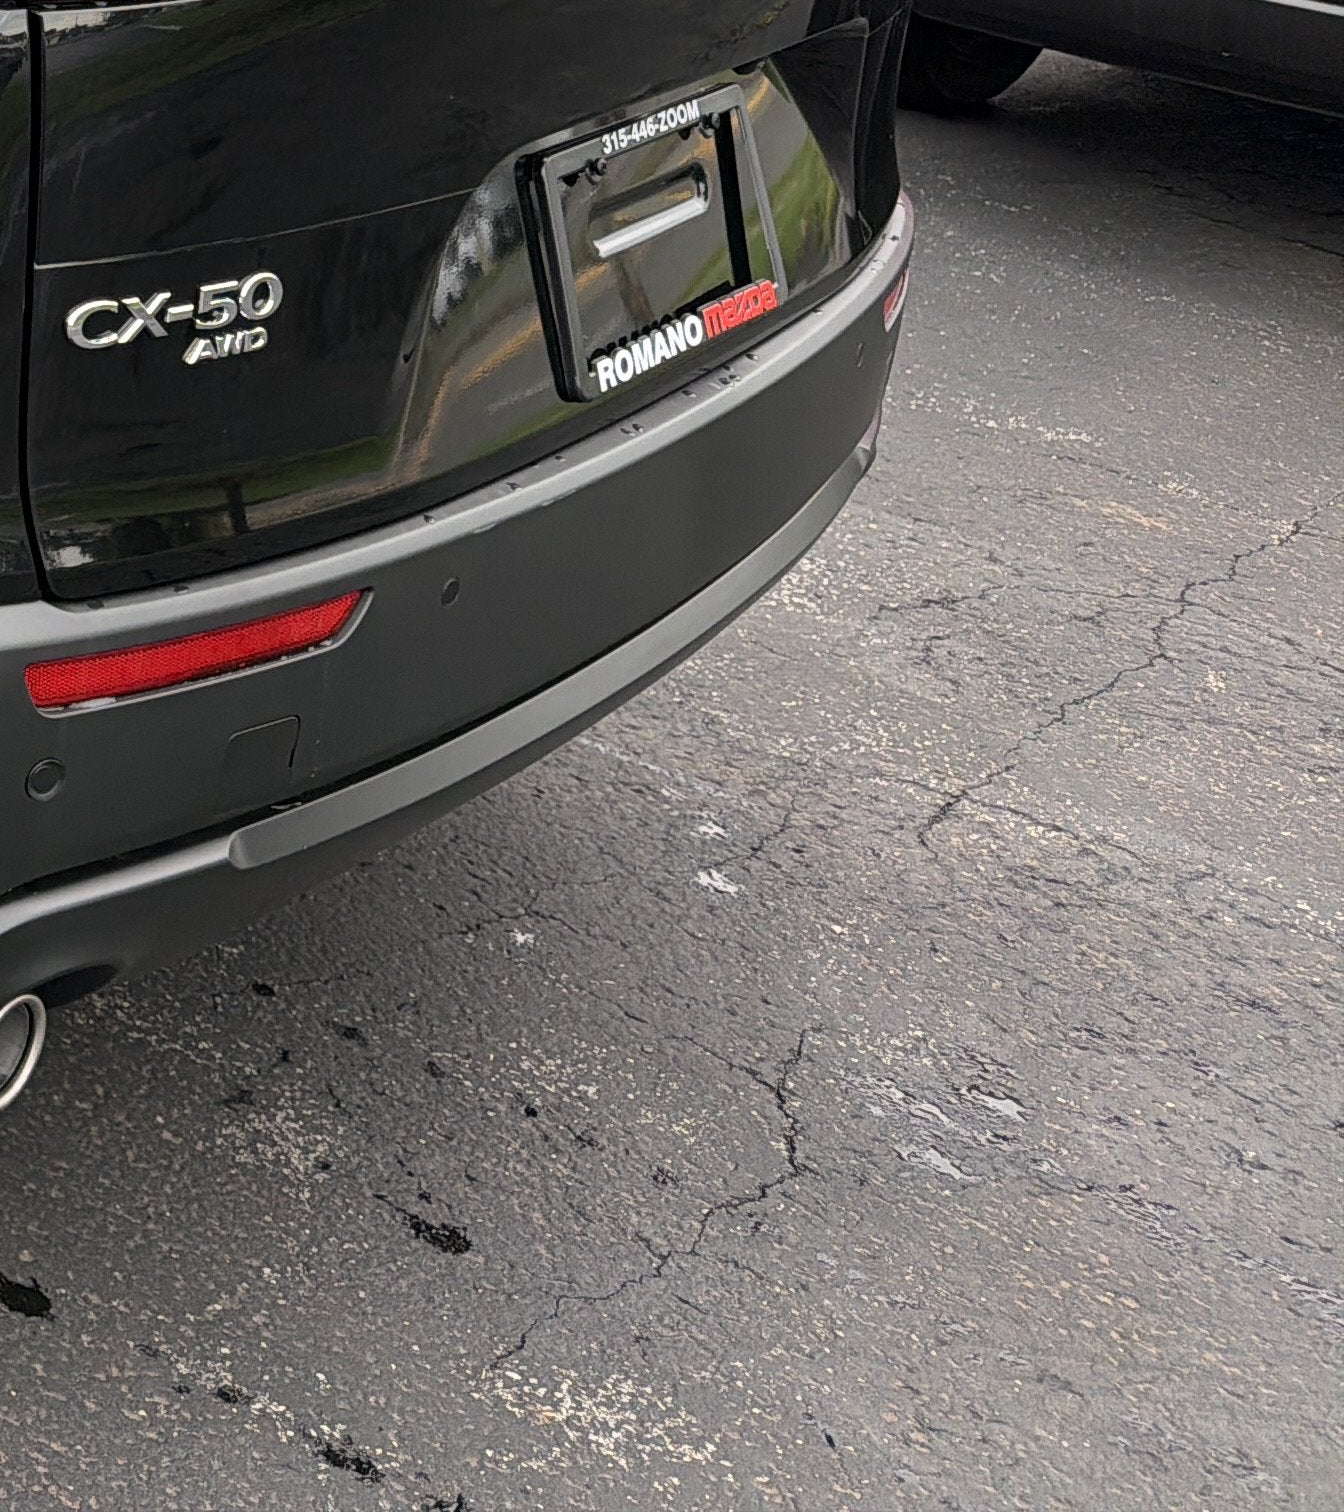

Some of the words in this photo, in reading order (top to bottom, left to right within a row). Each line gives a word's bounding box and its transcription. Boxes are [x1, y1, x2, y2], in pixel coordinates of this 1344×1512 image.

[601, 99, 700, 155] 315-446-ZOOM
[66, 271, 284, 349] CX-50
[182, 326, 268, 365] AWD
[593, 311, 703, 393] ROMANO
